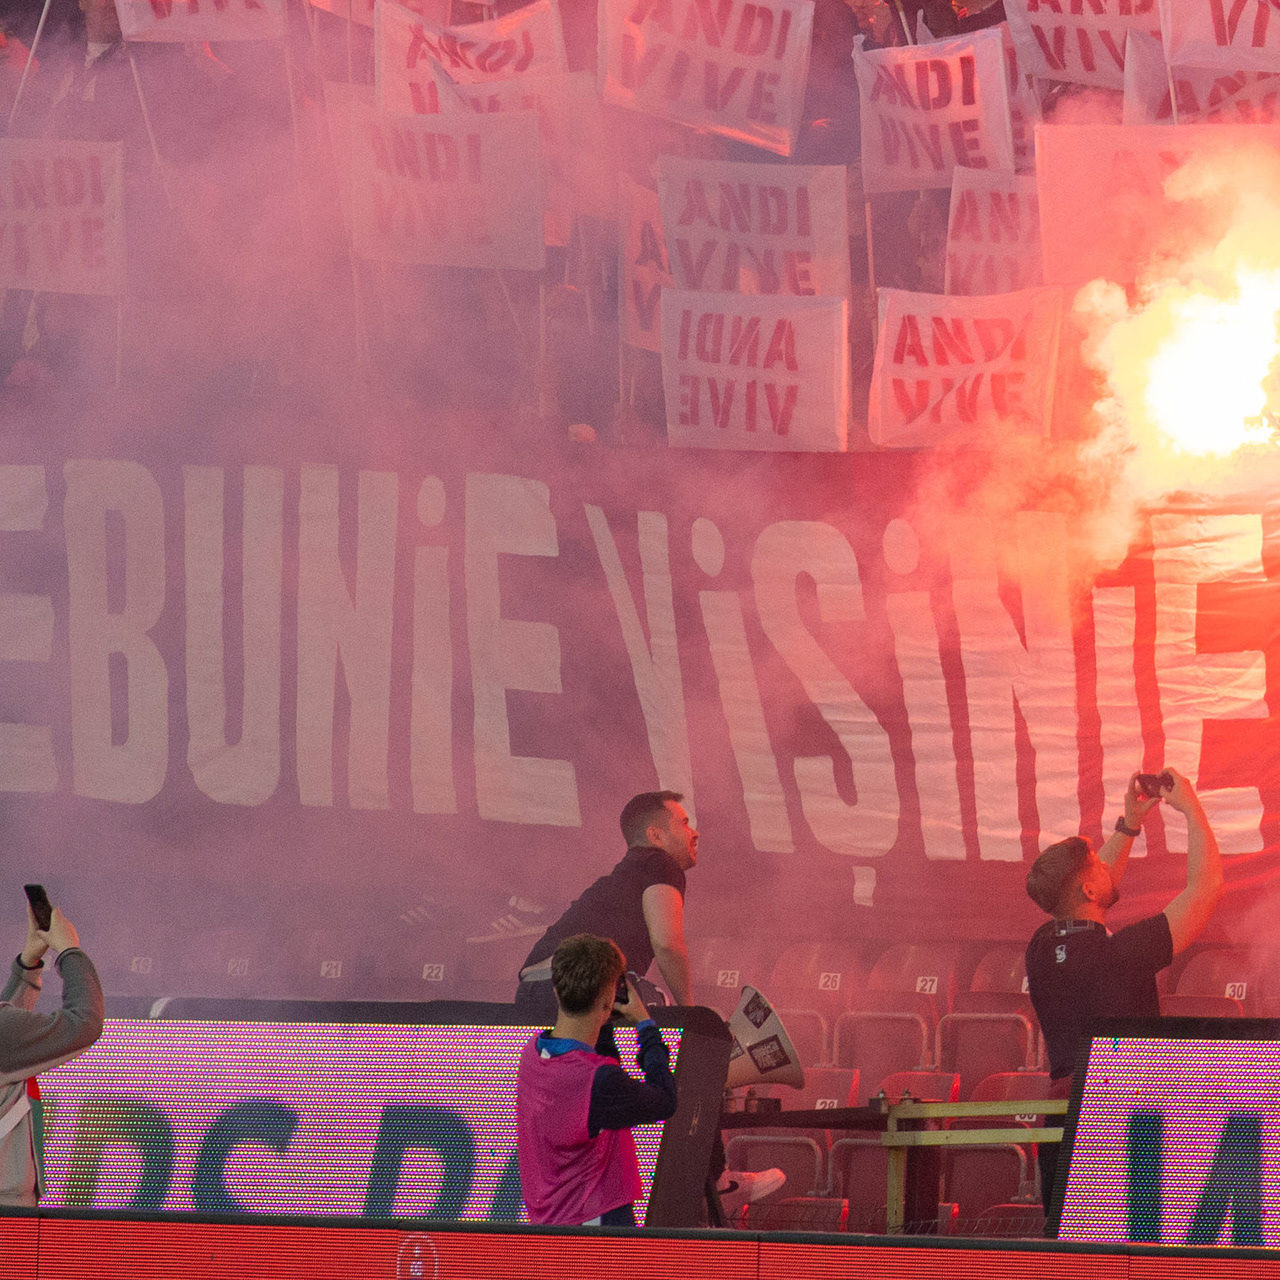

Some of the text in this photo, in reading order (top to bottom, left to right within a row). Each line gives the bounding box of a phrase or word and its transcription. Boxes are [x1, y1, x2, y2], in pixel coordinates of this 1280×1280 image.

[620, 32, 780, 121] VIVE
[678, 179, 810, 238] ANDI
[892, 308, 1028, 366] ANDI
[892, 372, 1026, 425] VIVE
[322, 963, 341, 976] 21
[424, 965, 443, 980] 22
[719, 971, 737, 986] 25
[822, 974, 838, 989] 26
[920, 977, 936, 993] 27
[1228, 983, 1245, 999] 30
